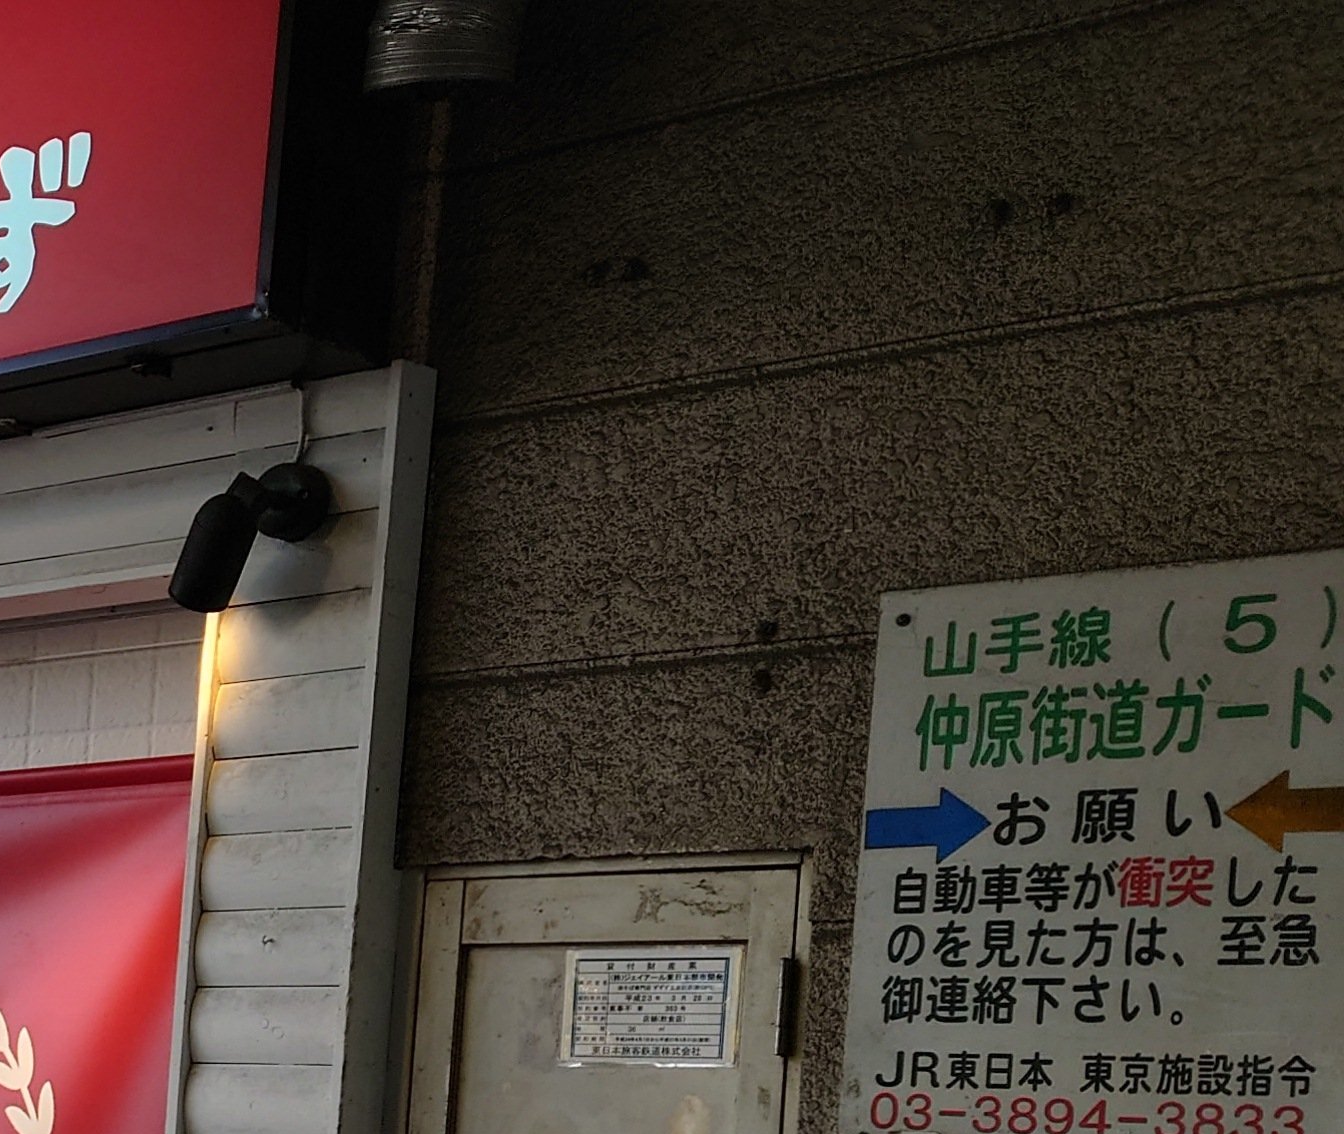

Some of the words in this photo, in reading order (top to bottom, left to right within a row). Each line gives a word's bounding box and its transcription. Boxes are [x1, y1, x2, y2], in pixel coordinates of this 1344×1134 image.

[915, 664, 1336, 772] 仲原街道ガード
[992, 787, 1223, 846] お願い
[893, 855, 1319, 916] 自動車等が衝突した
[887, 913, 1320, 969] のを見た方は、至急
[880, 974, 1188, 1026] 御連絡下さい。
[875, 1050, 1053, 1091] JR東日本
[1079, 1052, 1317, 1098] 東京施設指令
